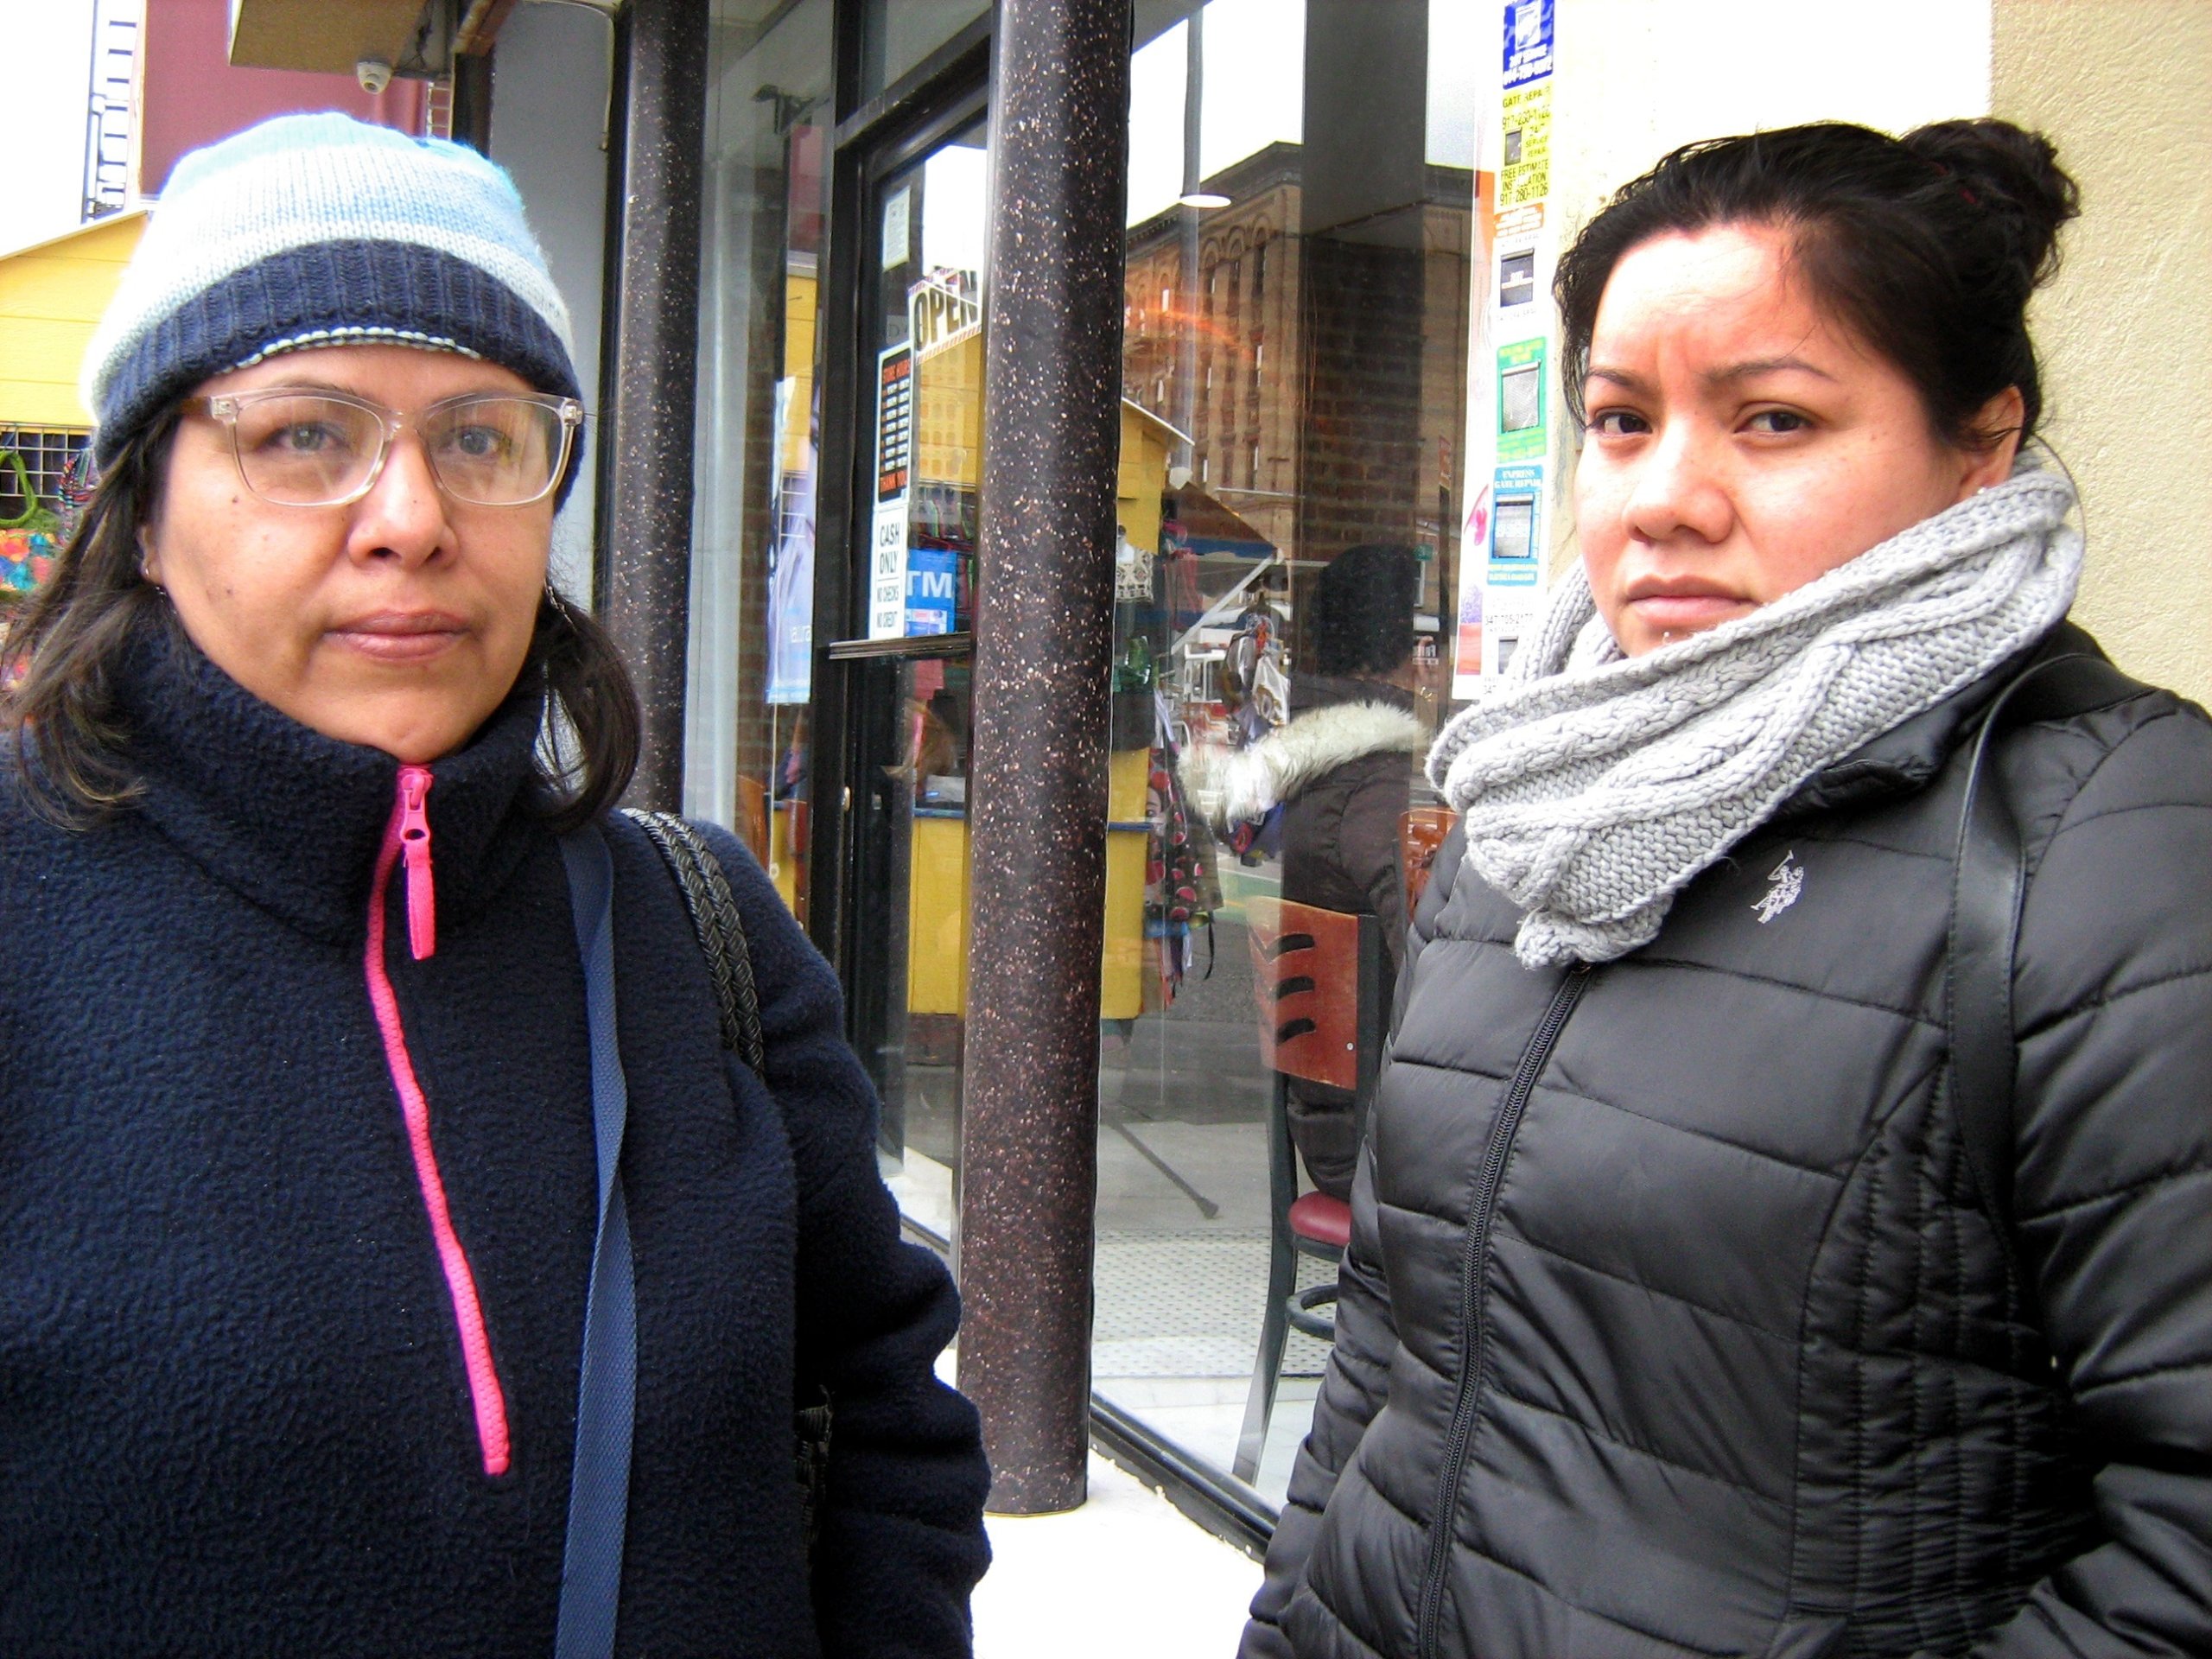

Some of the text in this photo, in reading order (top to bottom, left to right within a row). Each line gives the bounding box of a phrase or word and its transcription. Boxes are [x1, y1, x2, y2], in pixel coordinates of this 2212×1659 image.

[1524, 86, 1550, 101] REPAR
[1501, 167, 1516, 181] FREE
[1503, 172, 1547, 191] INSTLLATION
[914, 270, 978, 352] OPEN
[880, 523, 899, 547] CASH
[879, 550, 899, 575] ONLY
[907, 570, 953, 599] TM
[877, 587, 882, 602] NO
[877, 612, 882, 628] NO
